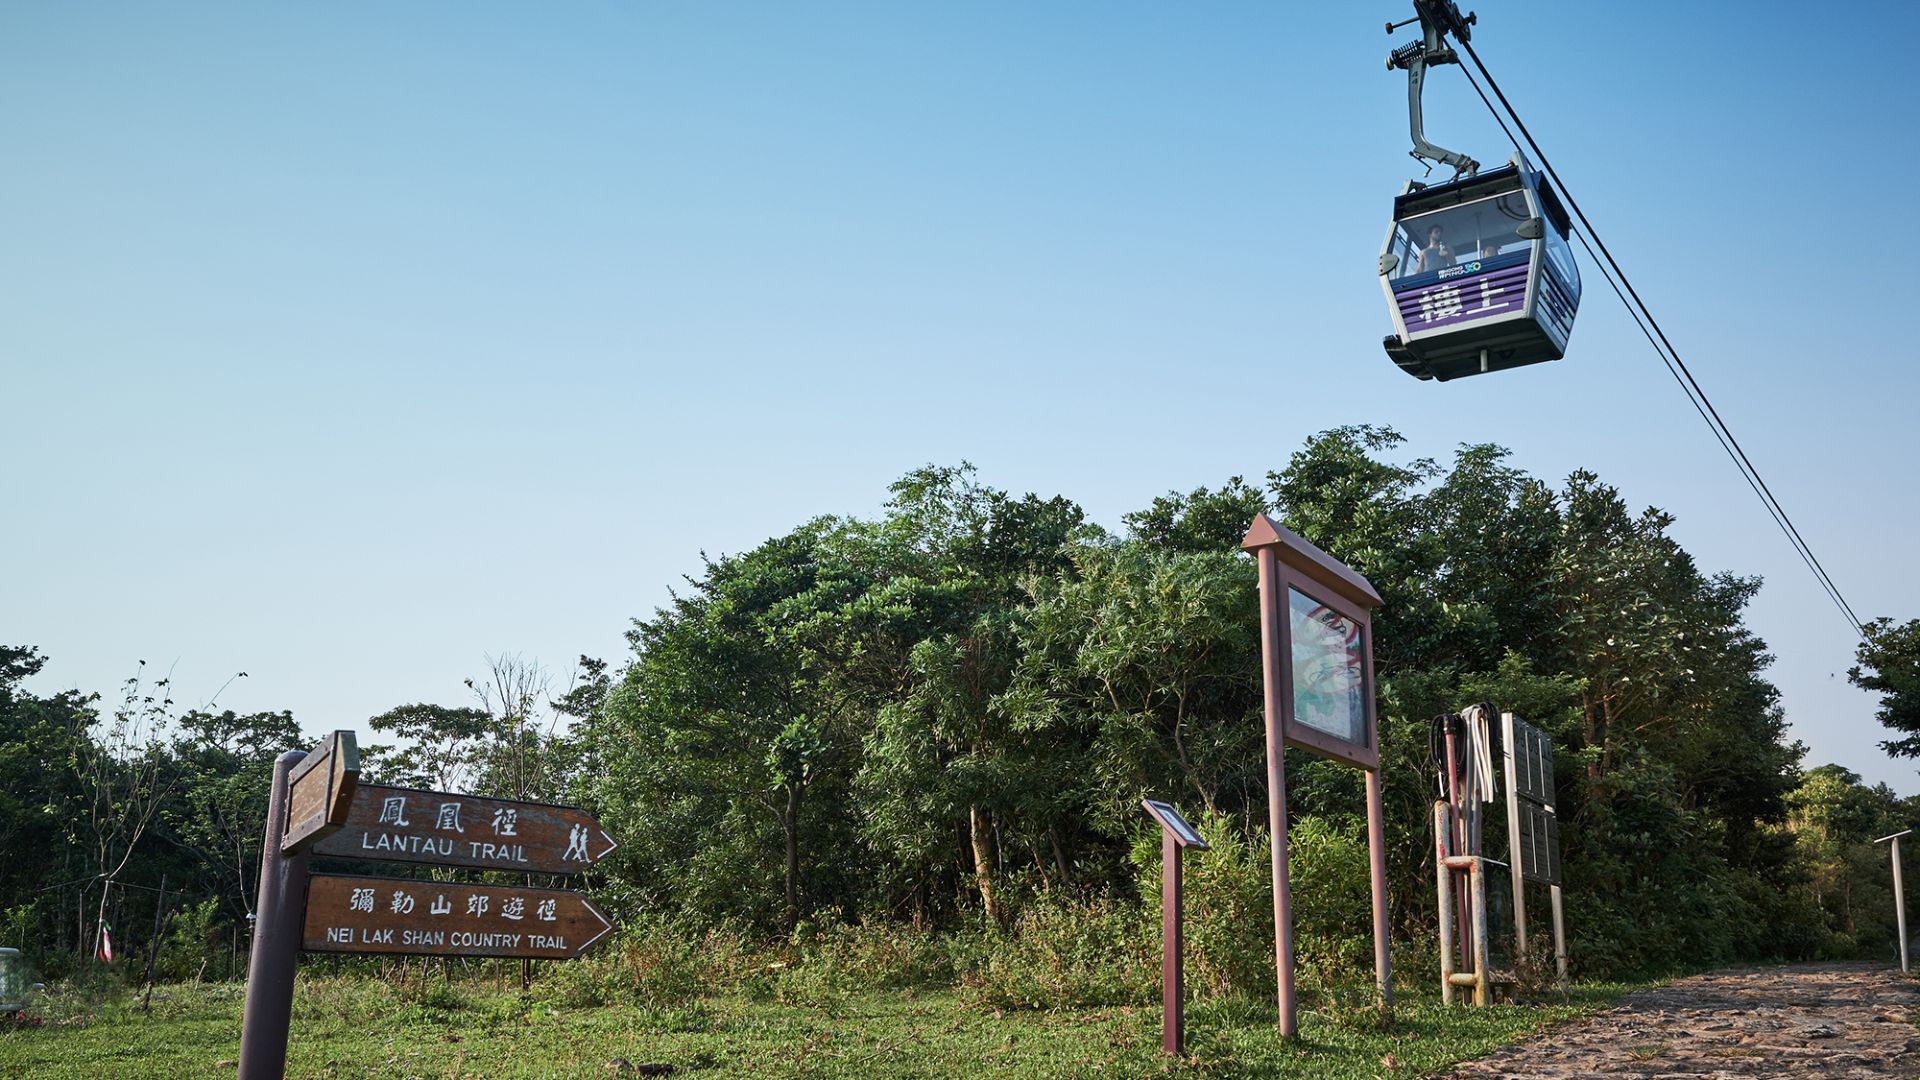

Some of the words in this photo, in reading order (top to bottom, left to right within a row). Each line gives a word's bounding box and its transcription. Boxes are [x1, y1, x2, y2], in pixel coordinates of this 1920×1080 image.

[1418, 277, 1510, 324] 樓上
[379, 796, 518, 837] 鳳凰徑
[361, 831, 454, 856] LANTAU
[469, 841, 529, 863] TRAIL
[349, 887, 558, 921] 彌勒山郊遊徑
[326, 927, 354, 943] NEI
[362, 927, 394, 944] LAK
[402, 929, 445, 946] SHAN
[450, 931, 521, 948] COUNTRY
[527, 934, 568, 950] TRAIL
